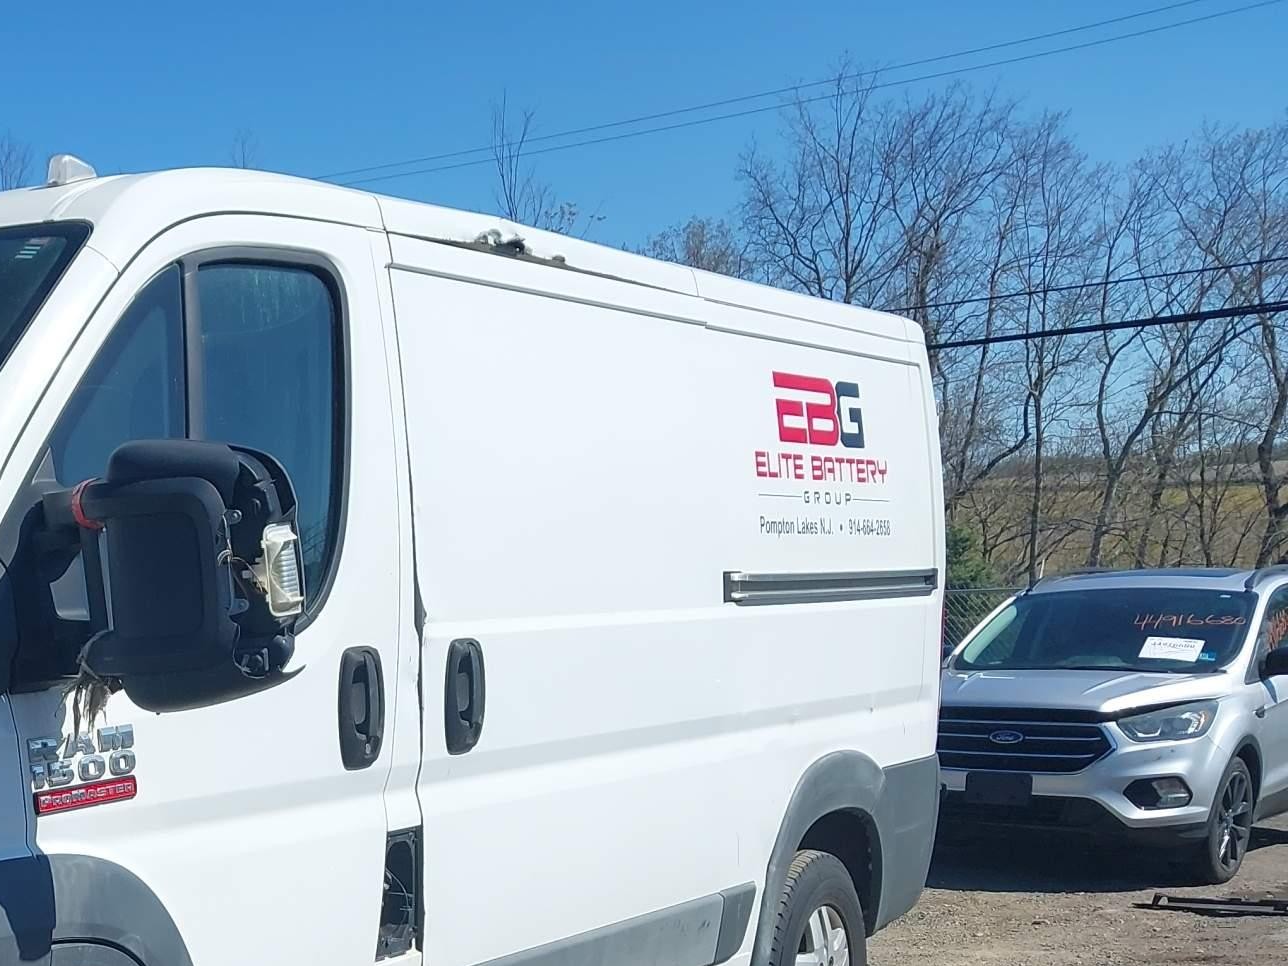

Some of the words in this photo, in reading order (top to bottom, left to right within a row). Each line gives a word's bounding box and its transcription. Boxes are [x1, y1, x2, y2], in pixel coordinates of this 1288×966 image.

[772, 371, 865, 449] EBG
[755, 451, 804, 480] ELITE
[811, 455, 887, 483] BATTERY
[803, 490, 852, 505] GROUP
[759, 515, 795, 539] Pompton
[796, 516, 818, 535] Lakes
[820, 518, 834, 535] N.J.
[1134, 613, 1246, 631] 44916680
[30, 749, 136, 790] 1500
